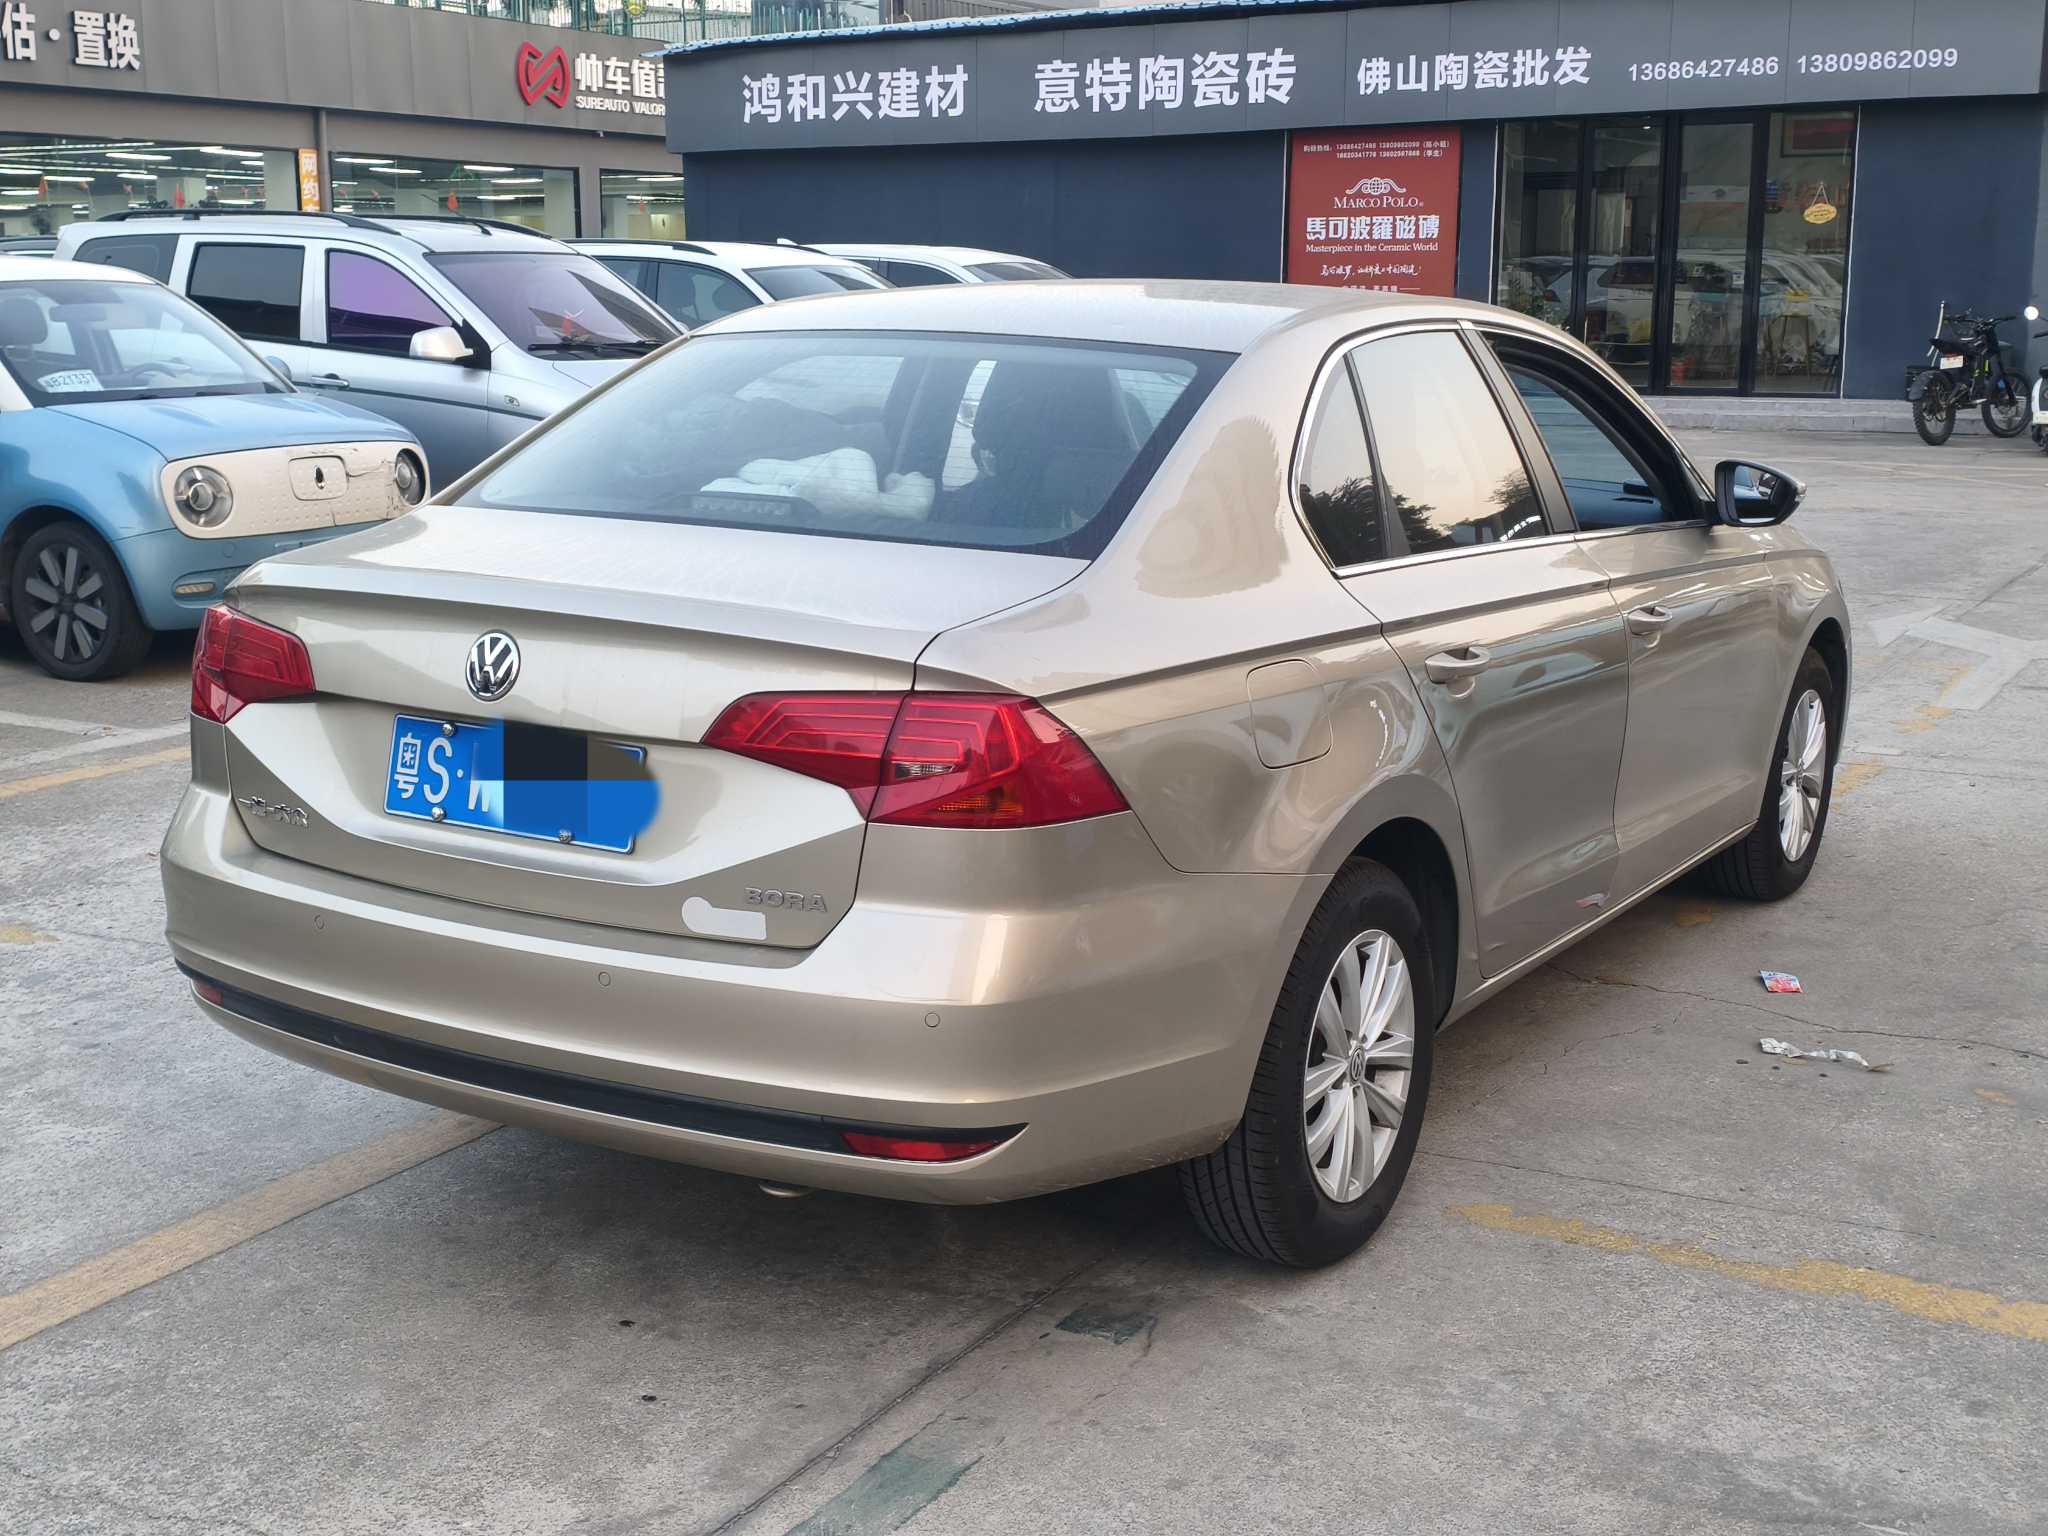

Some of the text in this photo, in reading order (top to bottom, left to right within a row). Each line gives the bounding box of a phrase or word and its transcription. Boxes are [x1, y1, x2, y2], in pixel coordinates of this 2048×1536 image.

[742, 46, 1959, 123] 鸿和兴建材 意特陶瓷砖 佛山陶瓷批发 13686427486 13809862099
[576, 96, 630, 112] SUREAUTO
[1334, 197, 1380, 208] MARCO
[1305, 241, 1439, 254] Masterpiece in the Ceramic World
[744, 887, 828, 912] BORA
